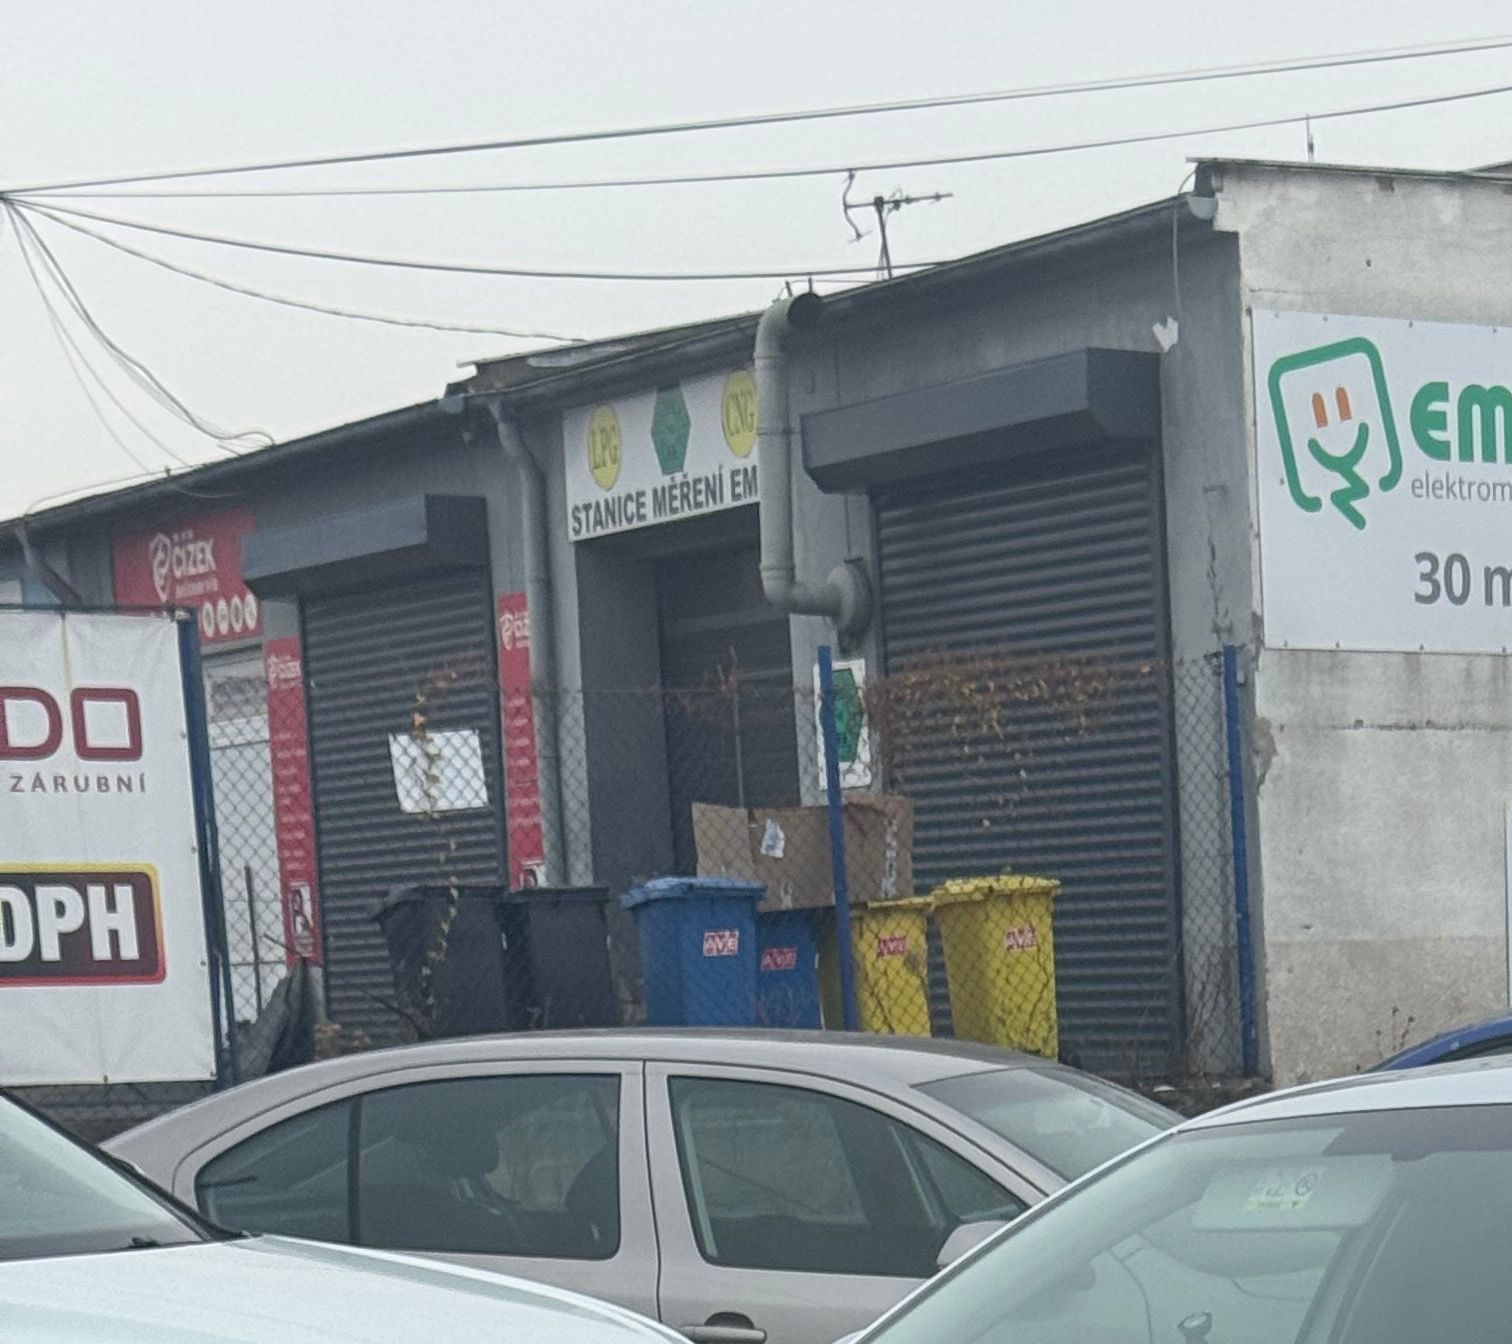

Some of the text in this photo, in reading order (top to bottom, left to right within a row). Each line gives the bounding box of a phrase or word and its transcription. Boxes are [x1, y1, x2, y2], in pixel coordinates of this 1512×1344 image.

[728, 390, 755, 436] CNG
[591, 424, 618, 470] LPG
[571, 490, 647, 536] STANICE
[652, 464, 724, 518] MĚŘENÍ
[1414, 552, 1471, 606] 30
[9, 771, 146, 793] ZÁRUBNÍ
[0, 884, 140, 962] DPH
[704, 932, 738, 955] AVE
